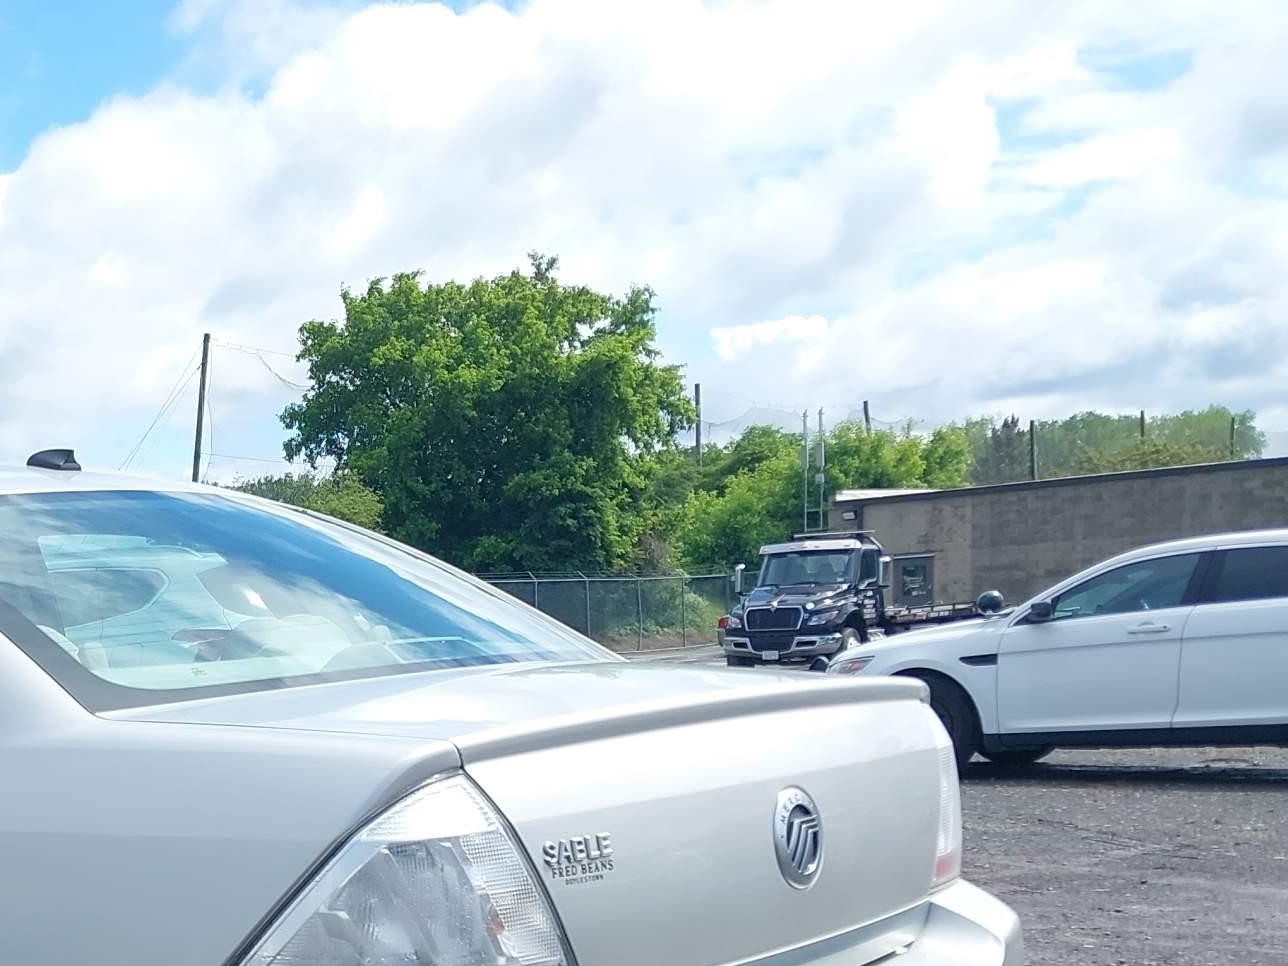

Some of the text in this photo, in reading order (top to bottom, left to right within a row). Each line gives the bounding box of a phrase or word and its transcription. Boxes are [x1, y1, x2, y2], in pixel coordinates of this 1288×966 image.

[542, 831, 614, 867] SABLE
[551, 859, 614, 879] FRED BEANS
